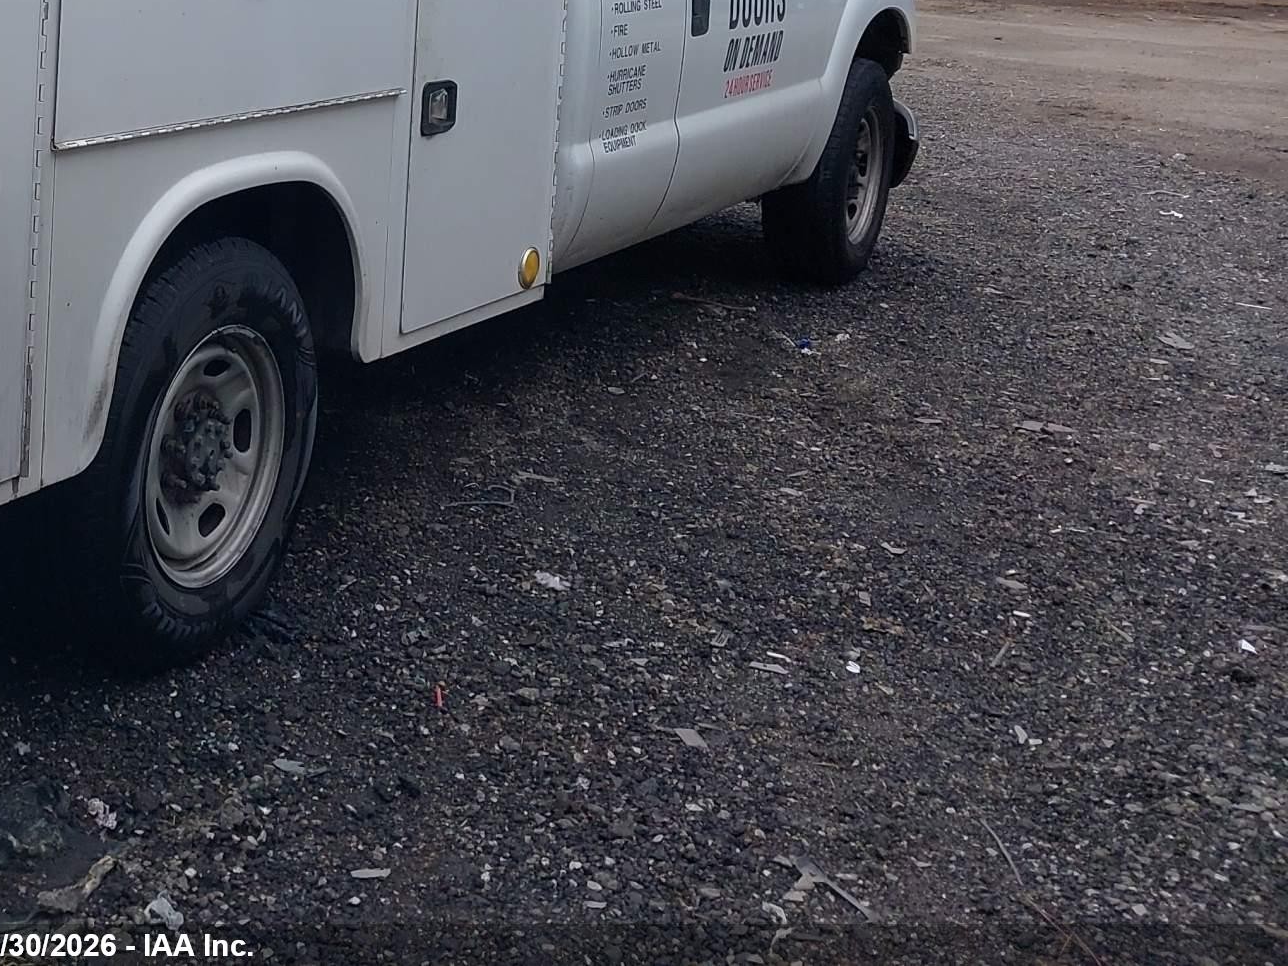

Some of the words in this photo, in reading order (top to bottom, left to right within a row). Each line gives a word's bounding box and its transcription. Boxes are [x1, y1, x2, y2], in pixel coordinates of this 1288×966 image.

[614, 0, 641, 15] ROLLING
[613, 23, 628, 38] FIRE
[611, 45, 639, 60] HOLLOW
[641, 41, 661, 54] METAL
[723, 38, 742, 73] ON
[739, 30, 784, 70] DEMAND
[609, 64, 647, 82] HURRICANE
[748, 69, 774, 93] SERVICE
[608, 78, 642, 96] SHUTTERS
[604, 103, 623, 118] STRIP
[624, 98, 647, 113] DOORS
[601, 125, 628, 141] LOADING
[630, 121, 647, 134] DOCK
[603, 135, 637, 153] EQUIPMENT
